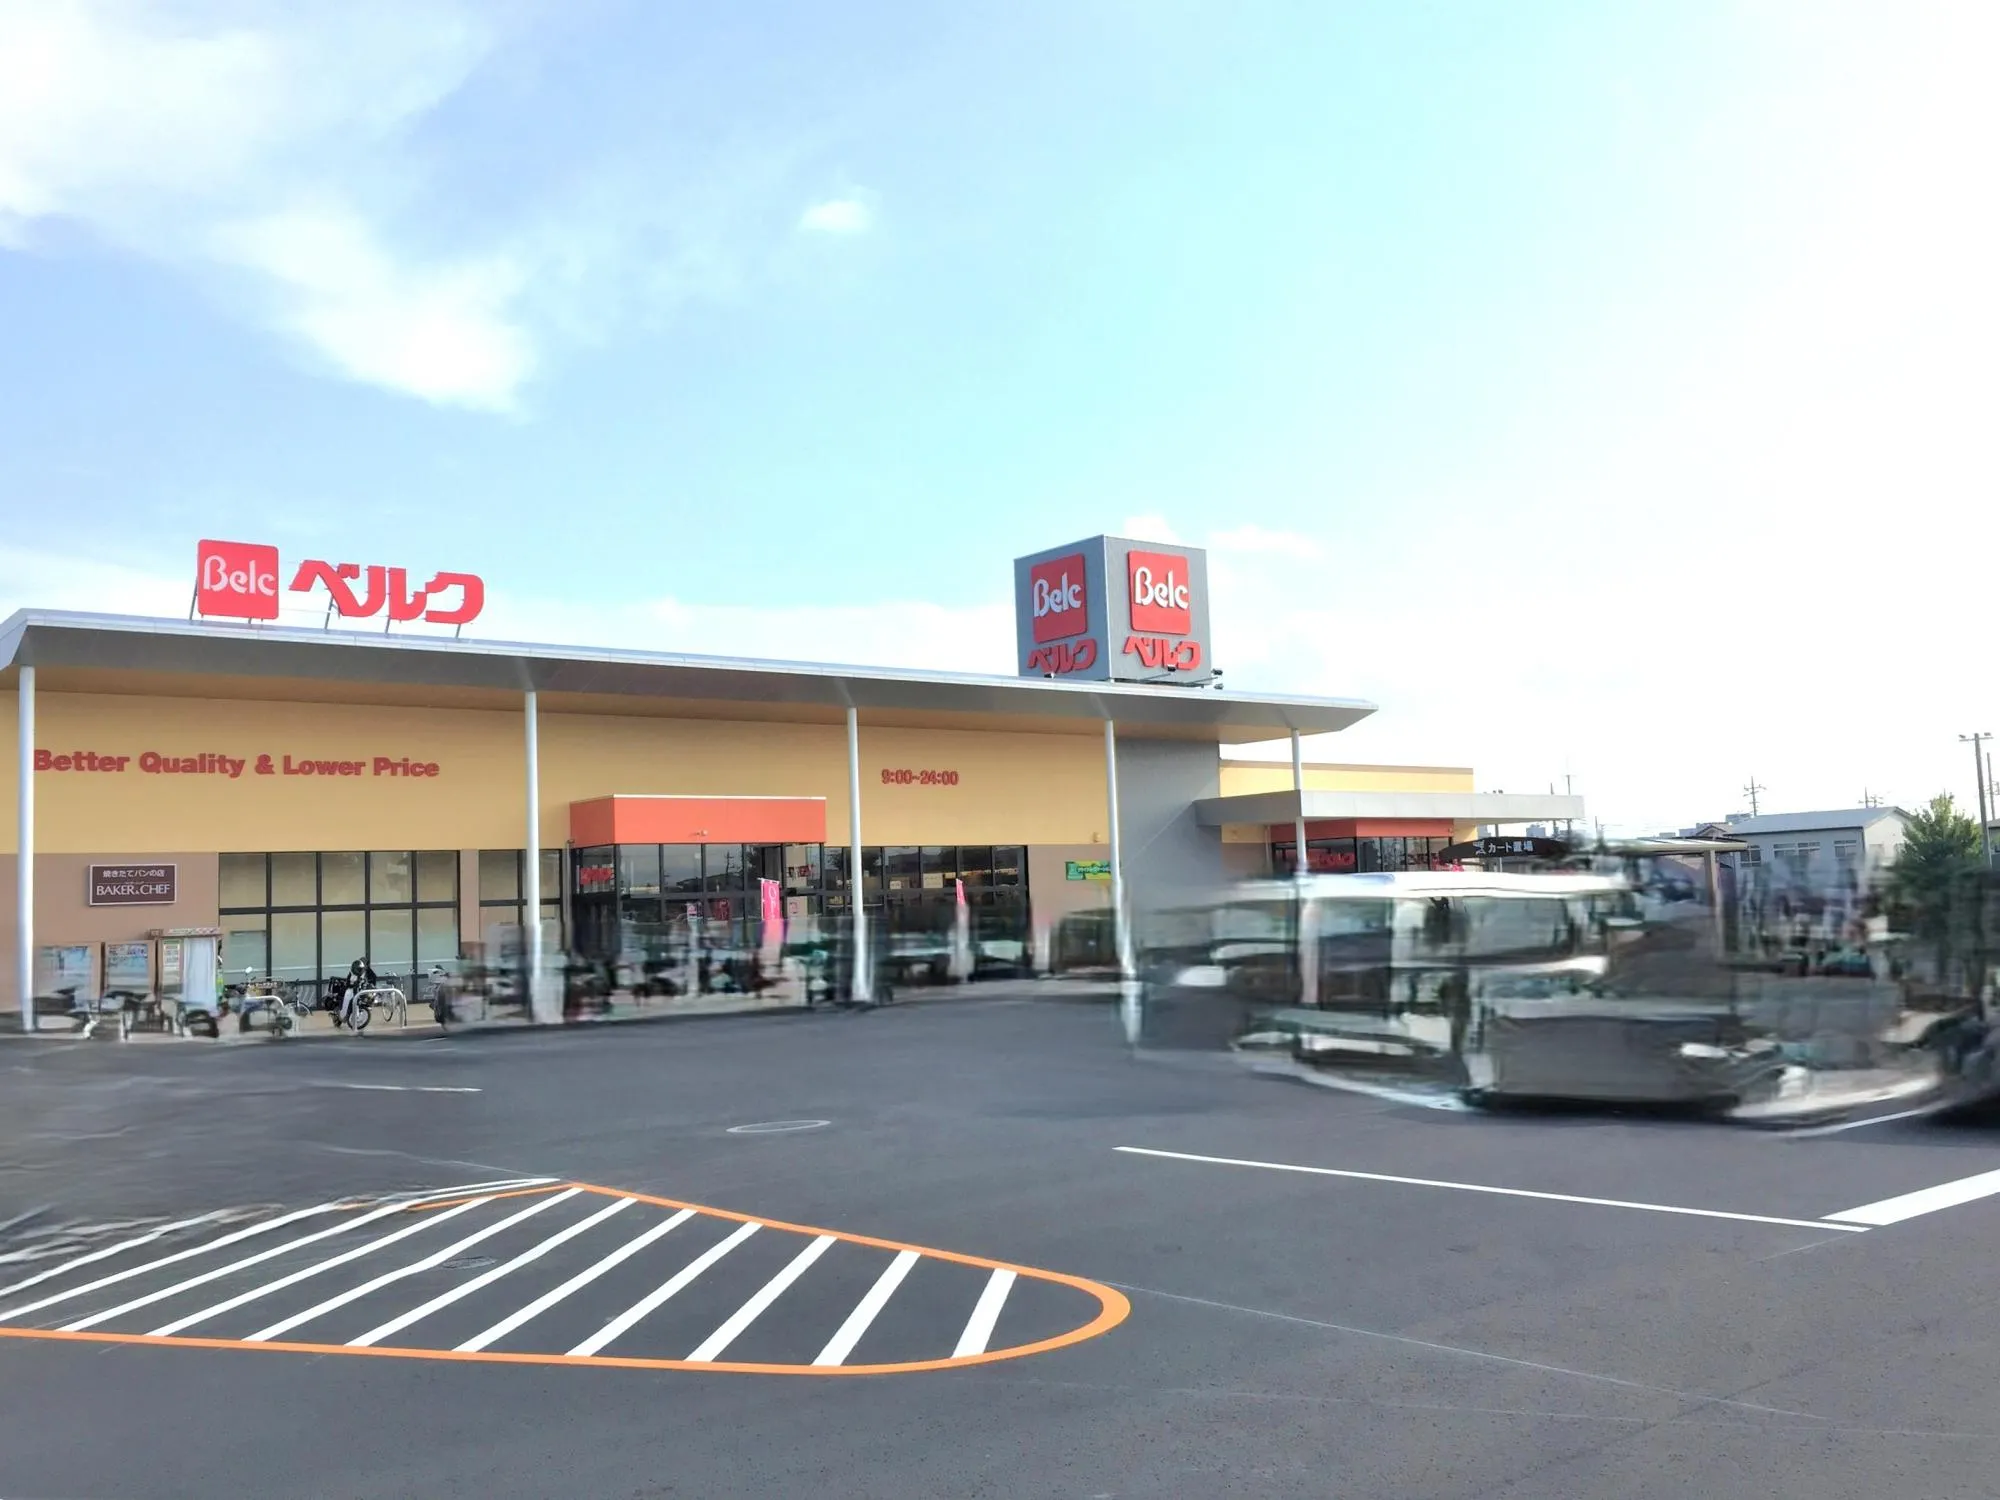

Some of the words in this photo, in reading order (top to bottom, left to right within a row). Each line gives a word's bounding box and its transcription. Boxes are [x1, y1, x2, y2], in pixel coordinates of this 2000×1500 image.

[203, 555, 276, 597] Belc
[289, 559, 485, 624] ベルク
[1033, 572, 1083, 618] Belc
[1135, 566, 1189, 609] Belc
[1027, 638, 1097, 674] ベルク
[1123, 636, 1202, 671] ベルク
[33, 749, 130, 772] Better
[139, 751, 246, 778] Quality
[254, 754, 276, 775] &
[283, 755, 366, 776] Lower
[373, 757, 440, 777] Price
[96, 885, 135, 896] BAKER
[140, 884, 171, 896] CHEF
